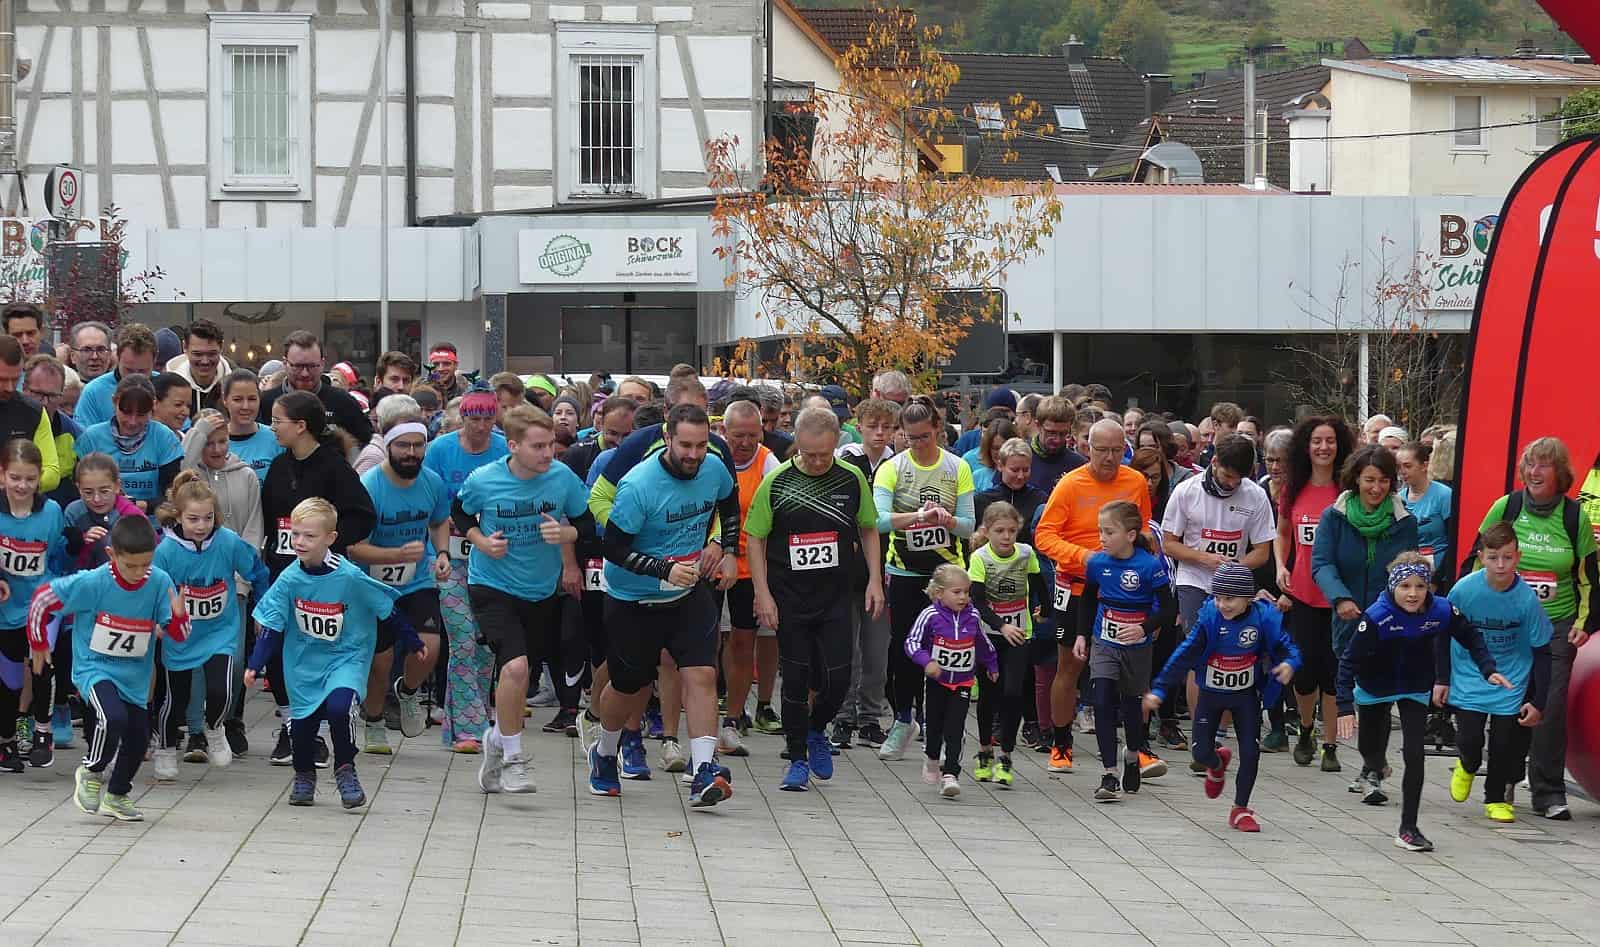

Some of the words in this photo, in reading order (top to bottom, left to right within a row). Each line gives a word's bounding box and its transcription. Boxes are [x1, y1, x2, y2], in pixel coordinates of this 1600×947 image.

[63, 181, 73, 196] 30
[628, 237, 682, 253] BOCK
[540, 245, 591, 268] ORIGINAL
[912, 528, 946, 547] 520
[1528, 533, 1550, 543] AOK
[796, 546, 833, 566] 323
[1206, 542, 1237, 557] 499
[3, 551, 40, 572] 104
[382, 566, 405, 582] 27
[186, 596, 222, 617] 105
[1055, 589, 1064, 606] 5
[300, 613, 338, 637] 106
[107, 631, 136, 653] 74
[938, 649, 972, 668] 522
[1212, 670, 1250, 688] 500
